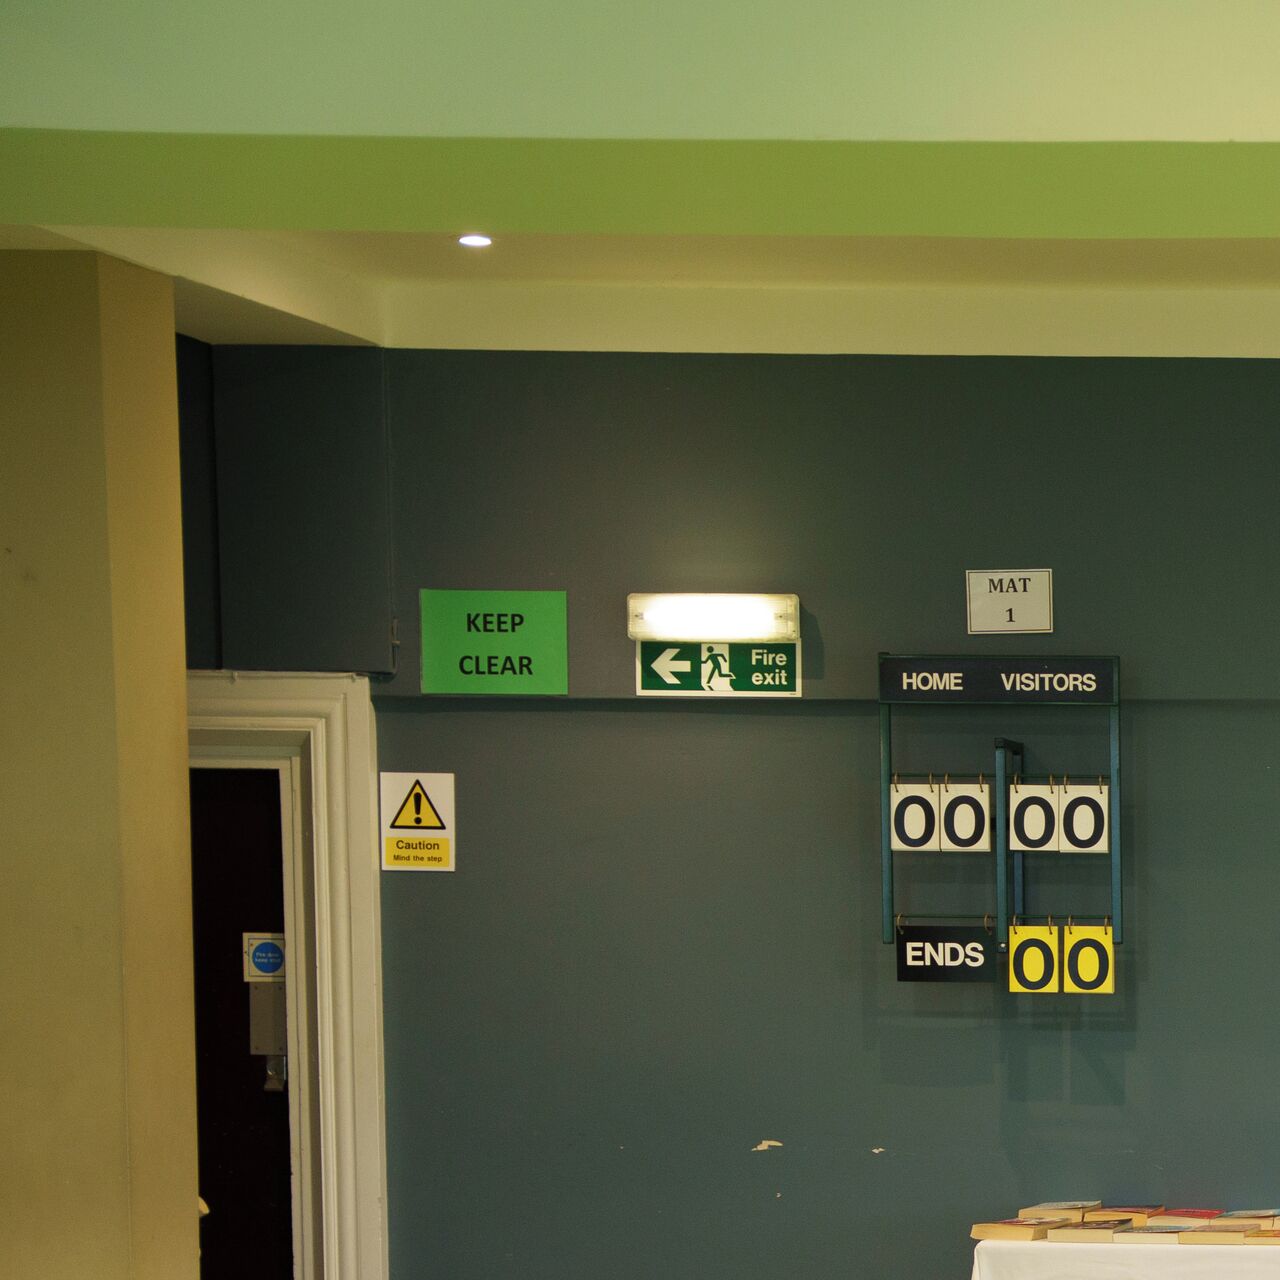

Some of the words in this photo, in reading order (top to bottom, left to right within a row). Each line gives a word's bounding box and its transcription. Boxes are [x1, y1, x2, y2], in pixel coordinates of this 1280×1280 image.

[987, 577, 1031, 594] MAT
[466, 613, 525, 634] KEEP
[1004, 608, 1016, 623] 1
[458, 655, 534, 676] CLEAR
[751, 649, 787, 667] Fire
[751, 668, 788, 687] exit
[901, 672, 963, 691] HOME
[1001, 672, 1097, 692] VISITORS
[893, 794, 985, 848] 00
[1013, 795, 1105, 850] 00
[396, 839, 440, 850] Caution
[393, 854, 411, 862] Mind
[427, 855, 443, 863] step
[905, 941, 985, 969] ENDS
[1013, 938, 1110, 991] 00
